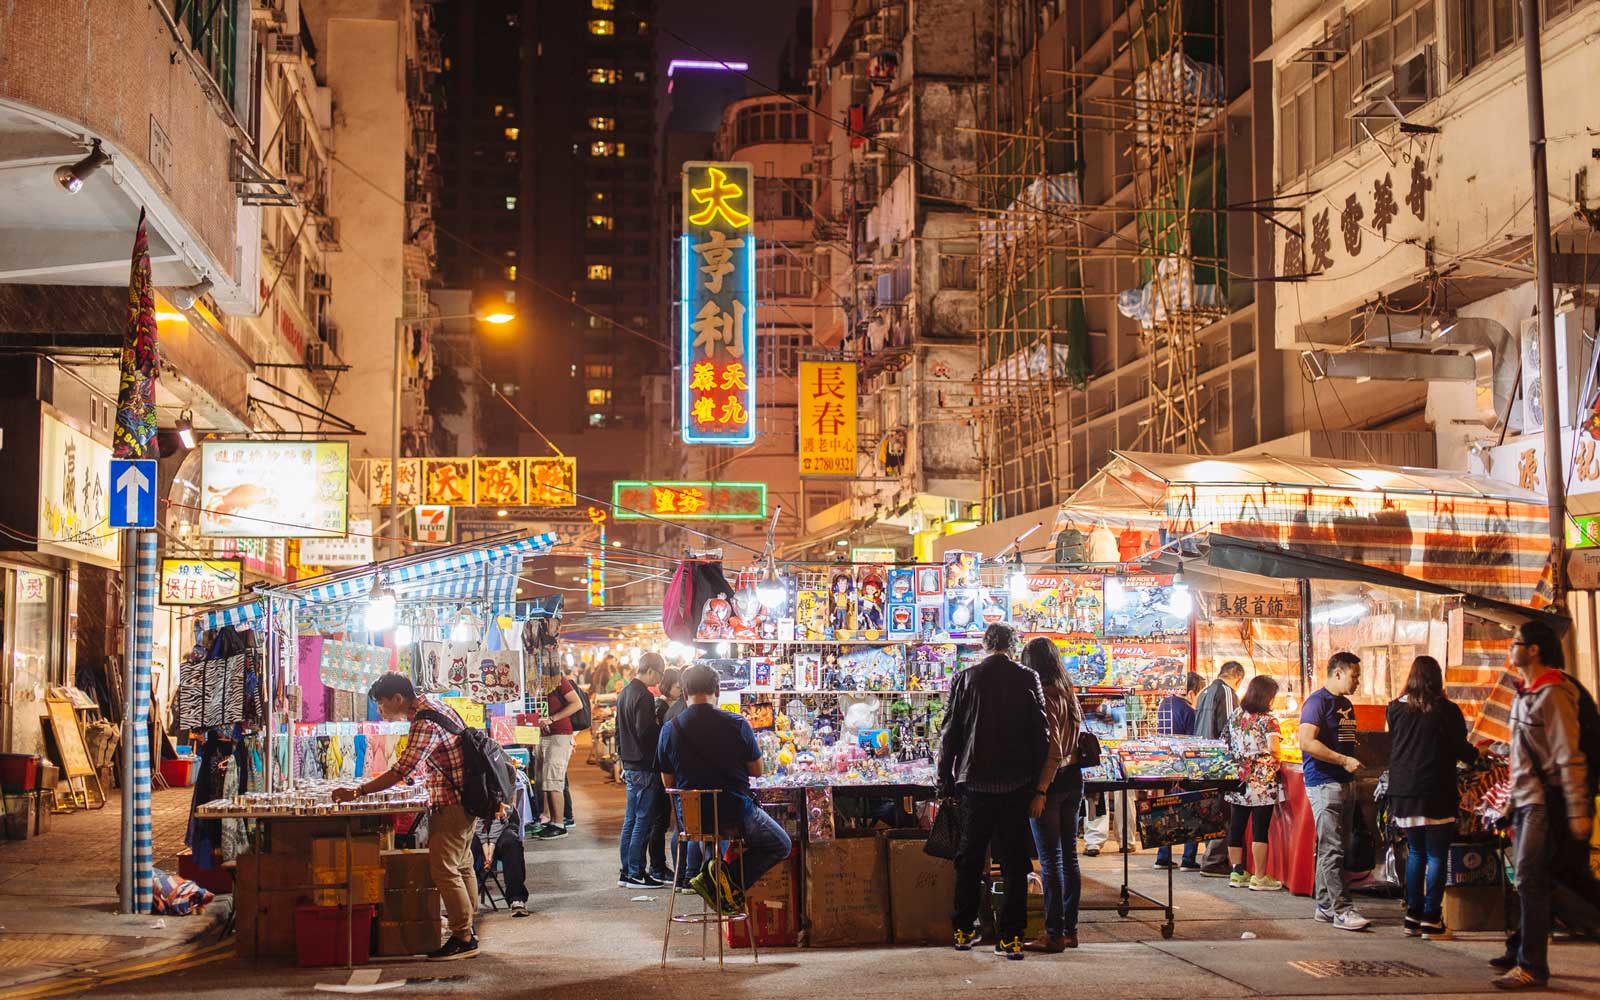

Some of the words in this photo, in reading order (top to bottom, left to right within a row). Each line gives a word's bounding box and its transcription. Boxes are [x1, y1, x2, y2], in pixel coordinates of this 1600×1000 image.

[812, 366, 845, 435] 長春
[166, 577, 215, 600] 煲仔飯
[1216, 593, 1283, 617] 真銀首飾
